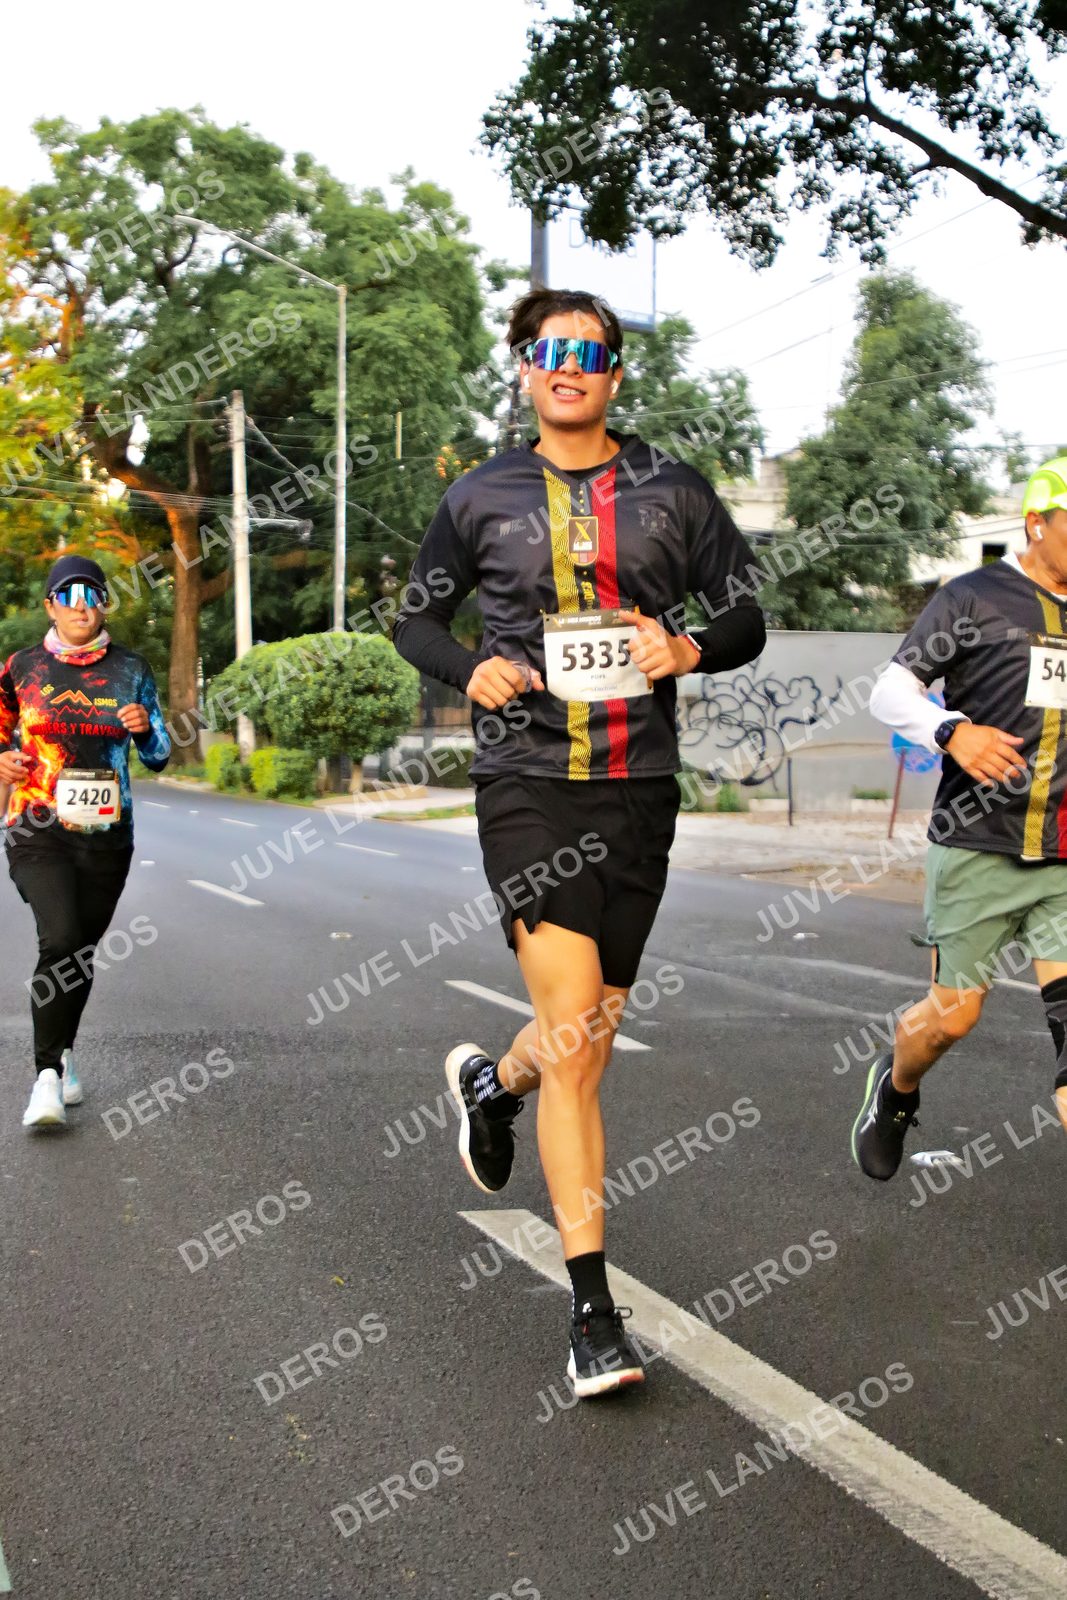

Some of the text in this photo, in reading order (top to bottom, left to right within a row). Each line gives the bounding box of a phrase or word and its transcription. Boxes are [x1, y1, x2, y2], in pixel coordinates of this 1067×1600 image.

[561, 638, 631, 672] 5335
[40, 683, 55, 697] LOS
[66, 787, 111, 806] 2420
